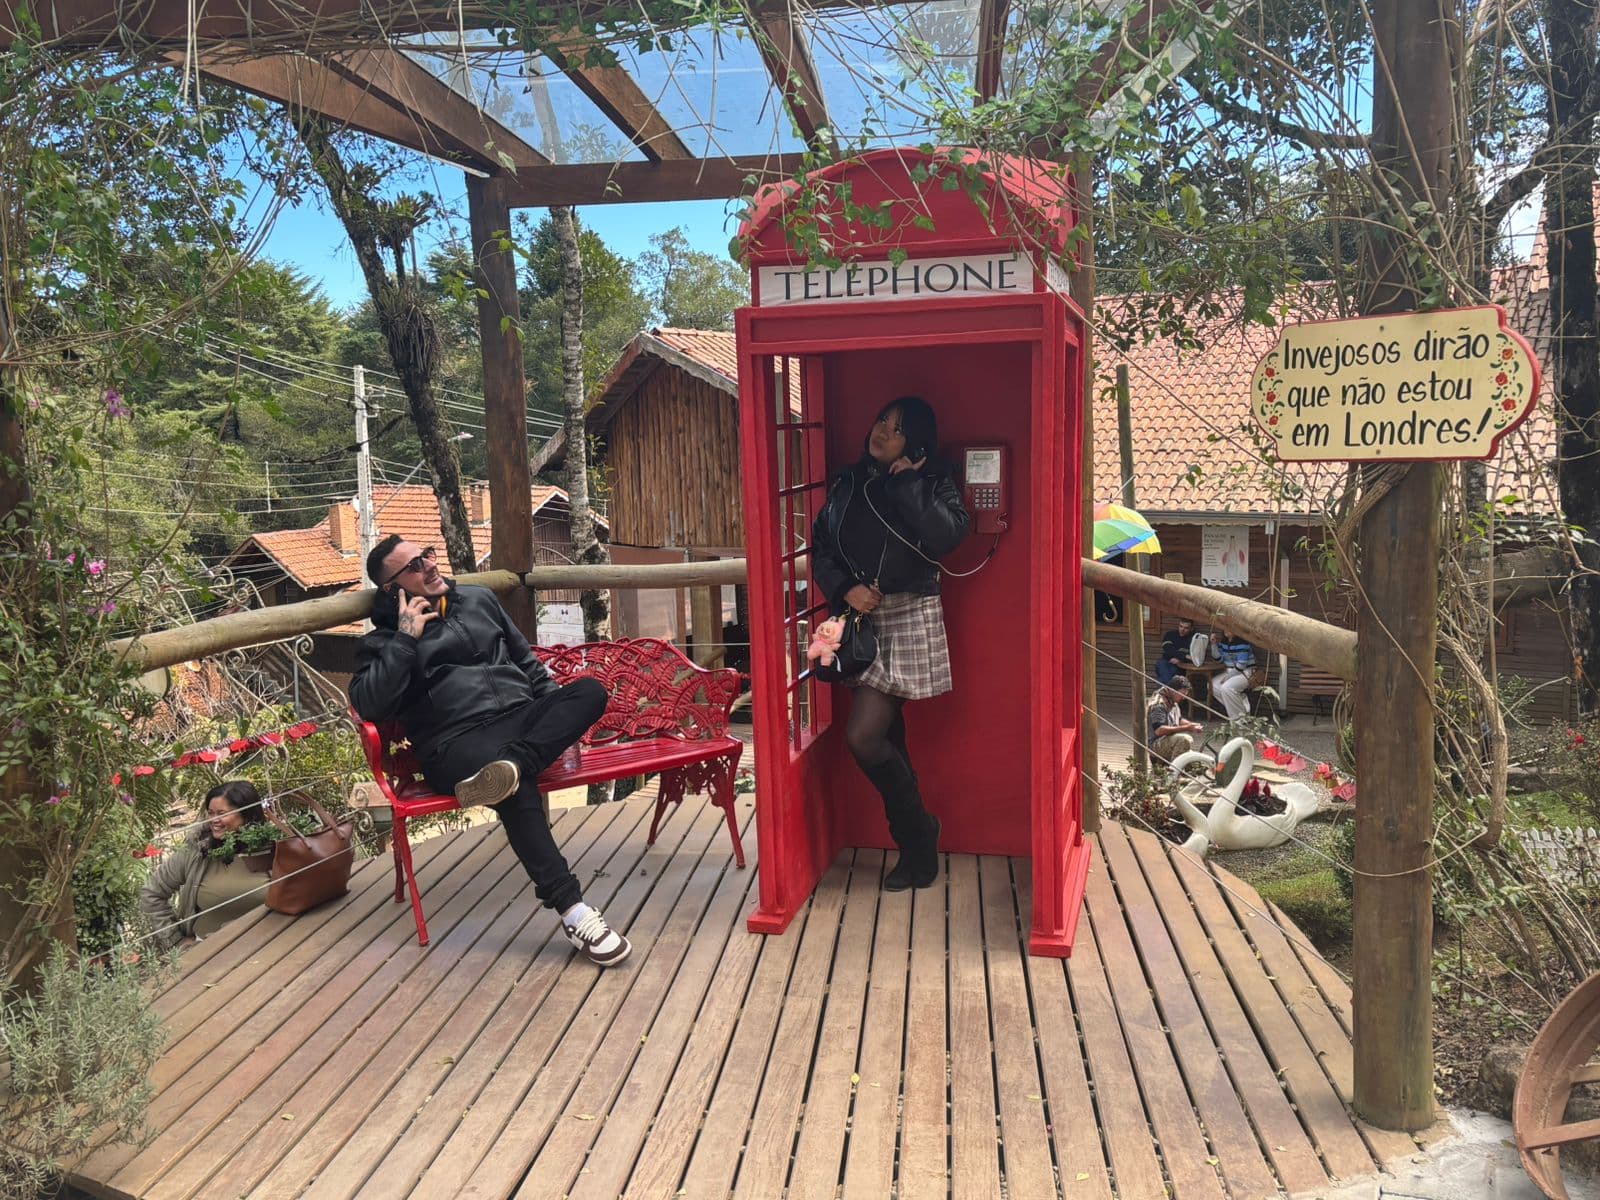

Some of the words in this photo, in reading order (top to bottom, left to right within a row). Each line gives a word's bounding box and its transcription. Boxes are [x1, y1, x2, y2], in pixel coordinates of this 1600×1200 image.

[774, 258, 1017, 300] TELEPHONE
[1284, 338, 1401, 375] Invejosos
[1414, 327, 1490, 362] dirão
[1287, 385, 1331, 417] que
[1341, 377, 1386, 406] não
[1397, 370, 1472, 402] estou
[1292, 422, 1329, 447] em
[1344, 407, 1493, 447] Londres!
